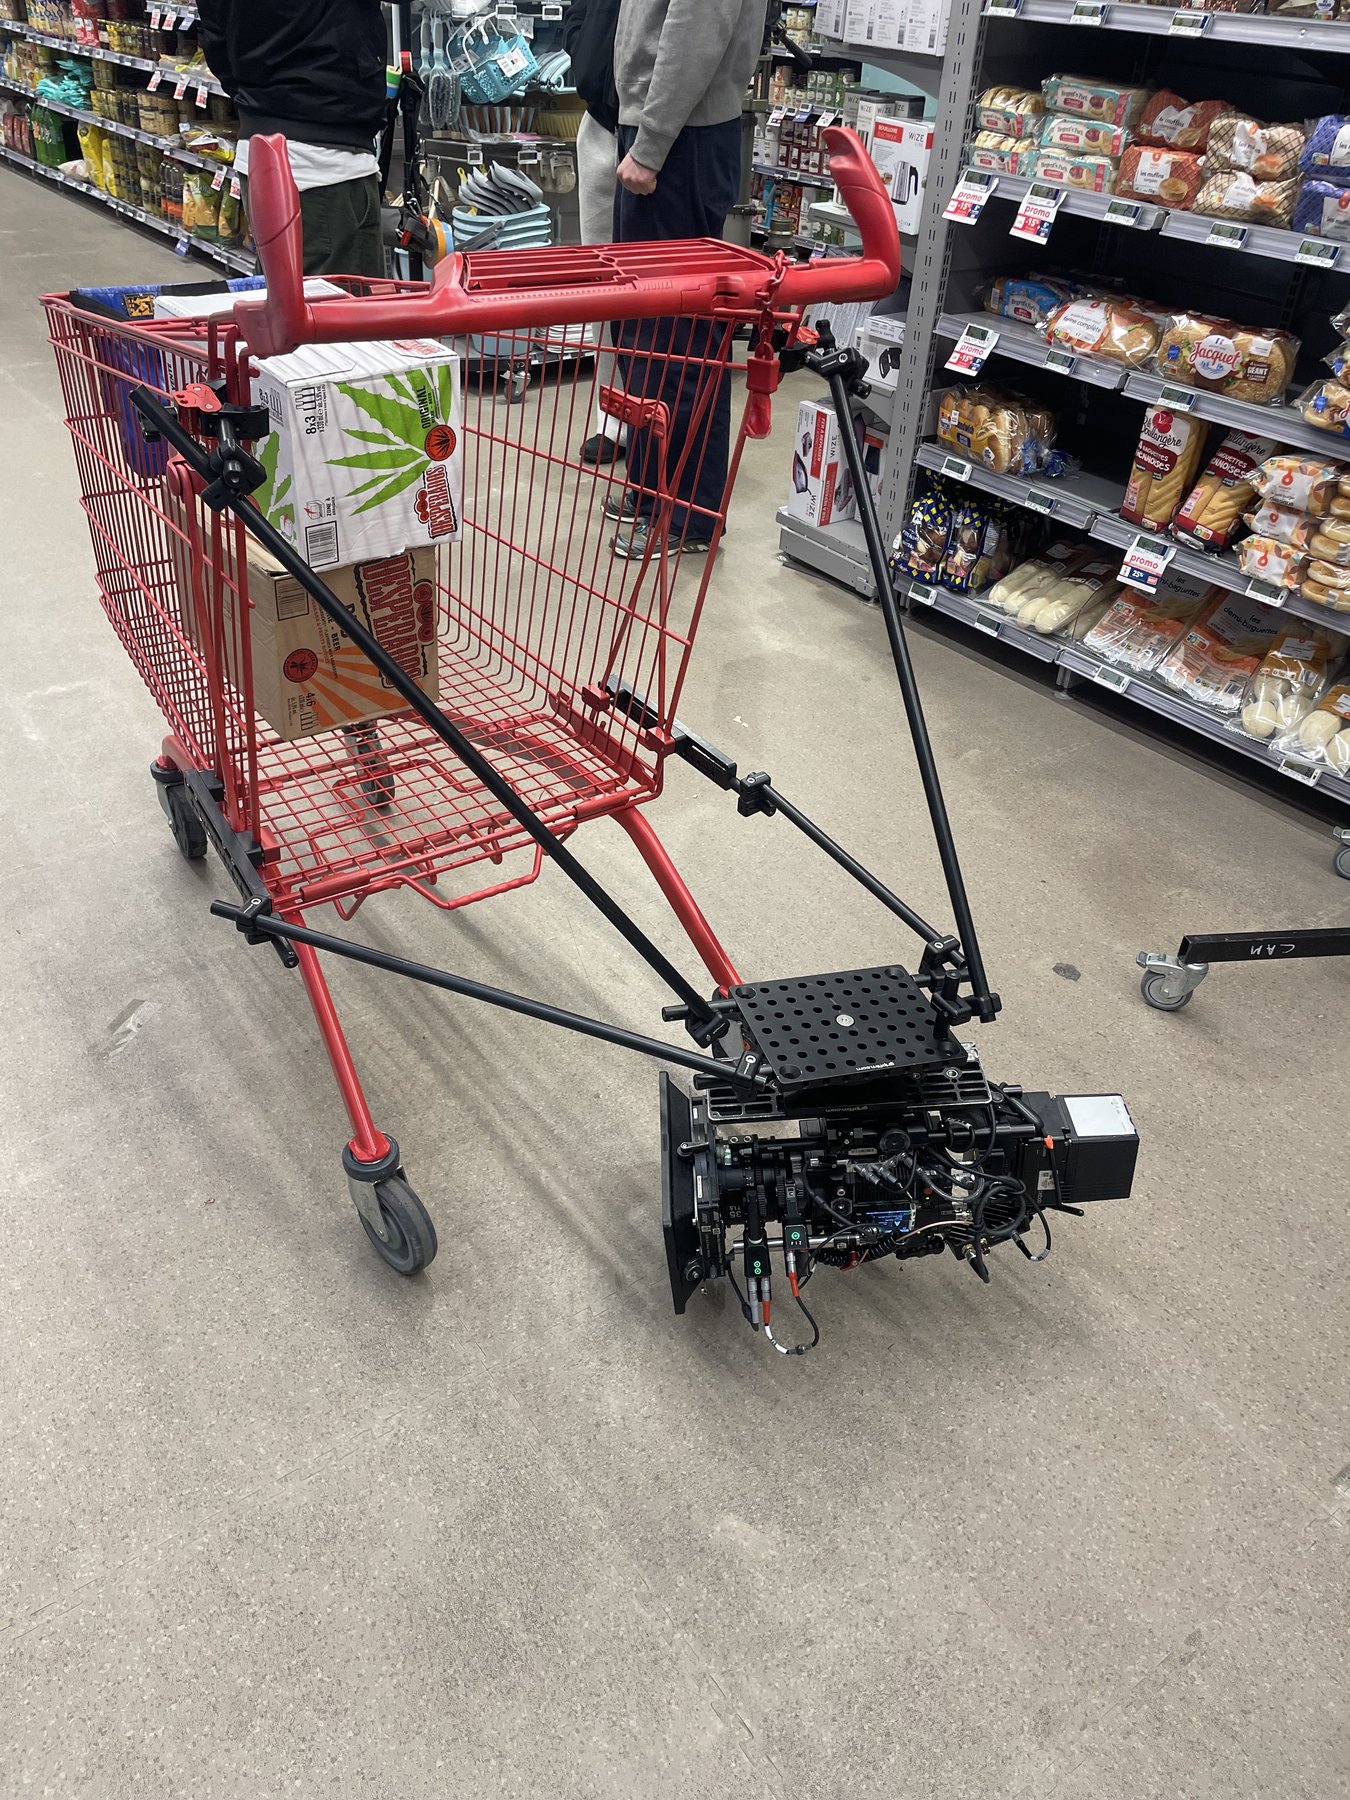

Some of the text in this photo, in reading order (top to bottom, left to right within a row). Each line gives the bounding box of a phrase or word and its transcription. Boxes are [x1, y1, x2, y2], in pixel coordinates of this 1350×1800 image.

[908, 132, 924, 142] WIZE
[1148, 170, 1165, 179] muffins
[958, 192, 982, 202] promo
[1024, 205, 1050, 218] promo
[959, 344, 984, 356] promo
[1188, 341, 1242, 370] Jacquet
[416, 386, 431, 430] ORIGINAL
[305, 416, 317, 435] 8x3
[426, 466, 454, 536] DESPERADOS
[1130, 554, 1158, 570] promo
[1176, 576, 1186, 584] les
[1224, 607, 1278, 636] demi-baguettes
[1250, 614, 1261, 624] les
[331, 633, 341, 652] BEER
[1250, 944, 1296, 956] CAM
[856, 1061, 895, 1072] gripfilm.com
[730, 1210, 742, 1218] 35
